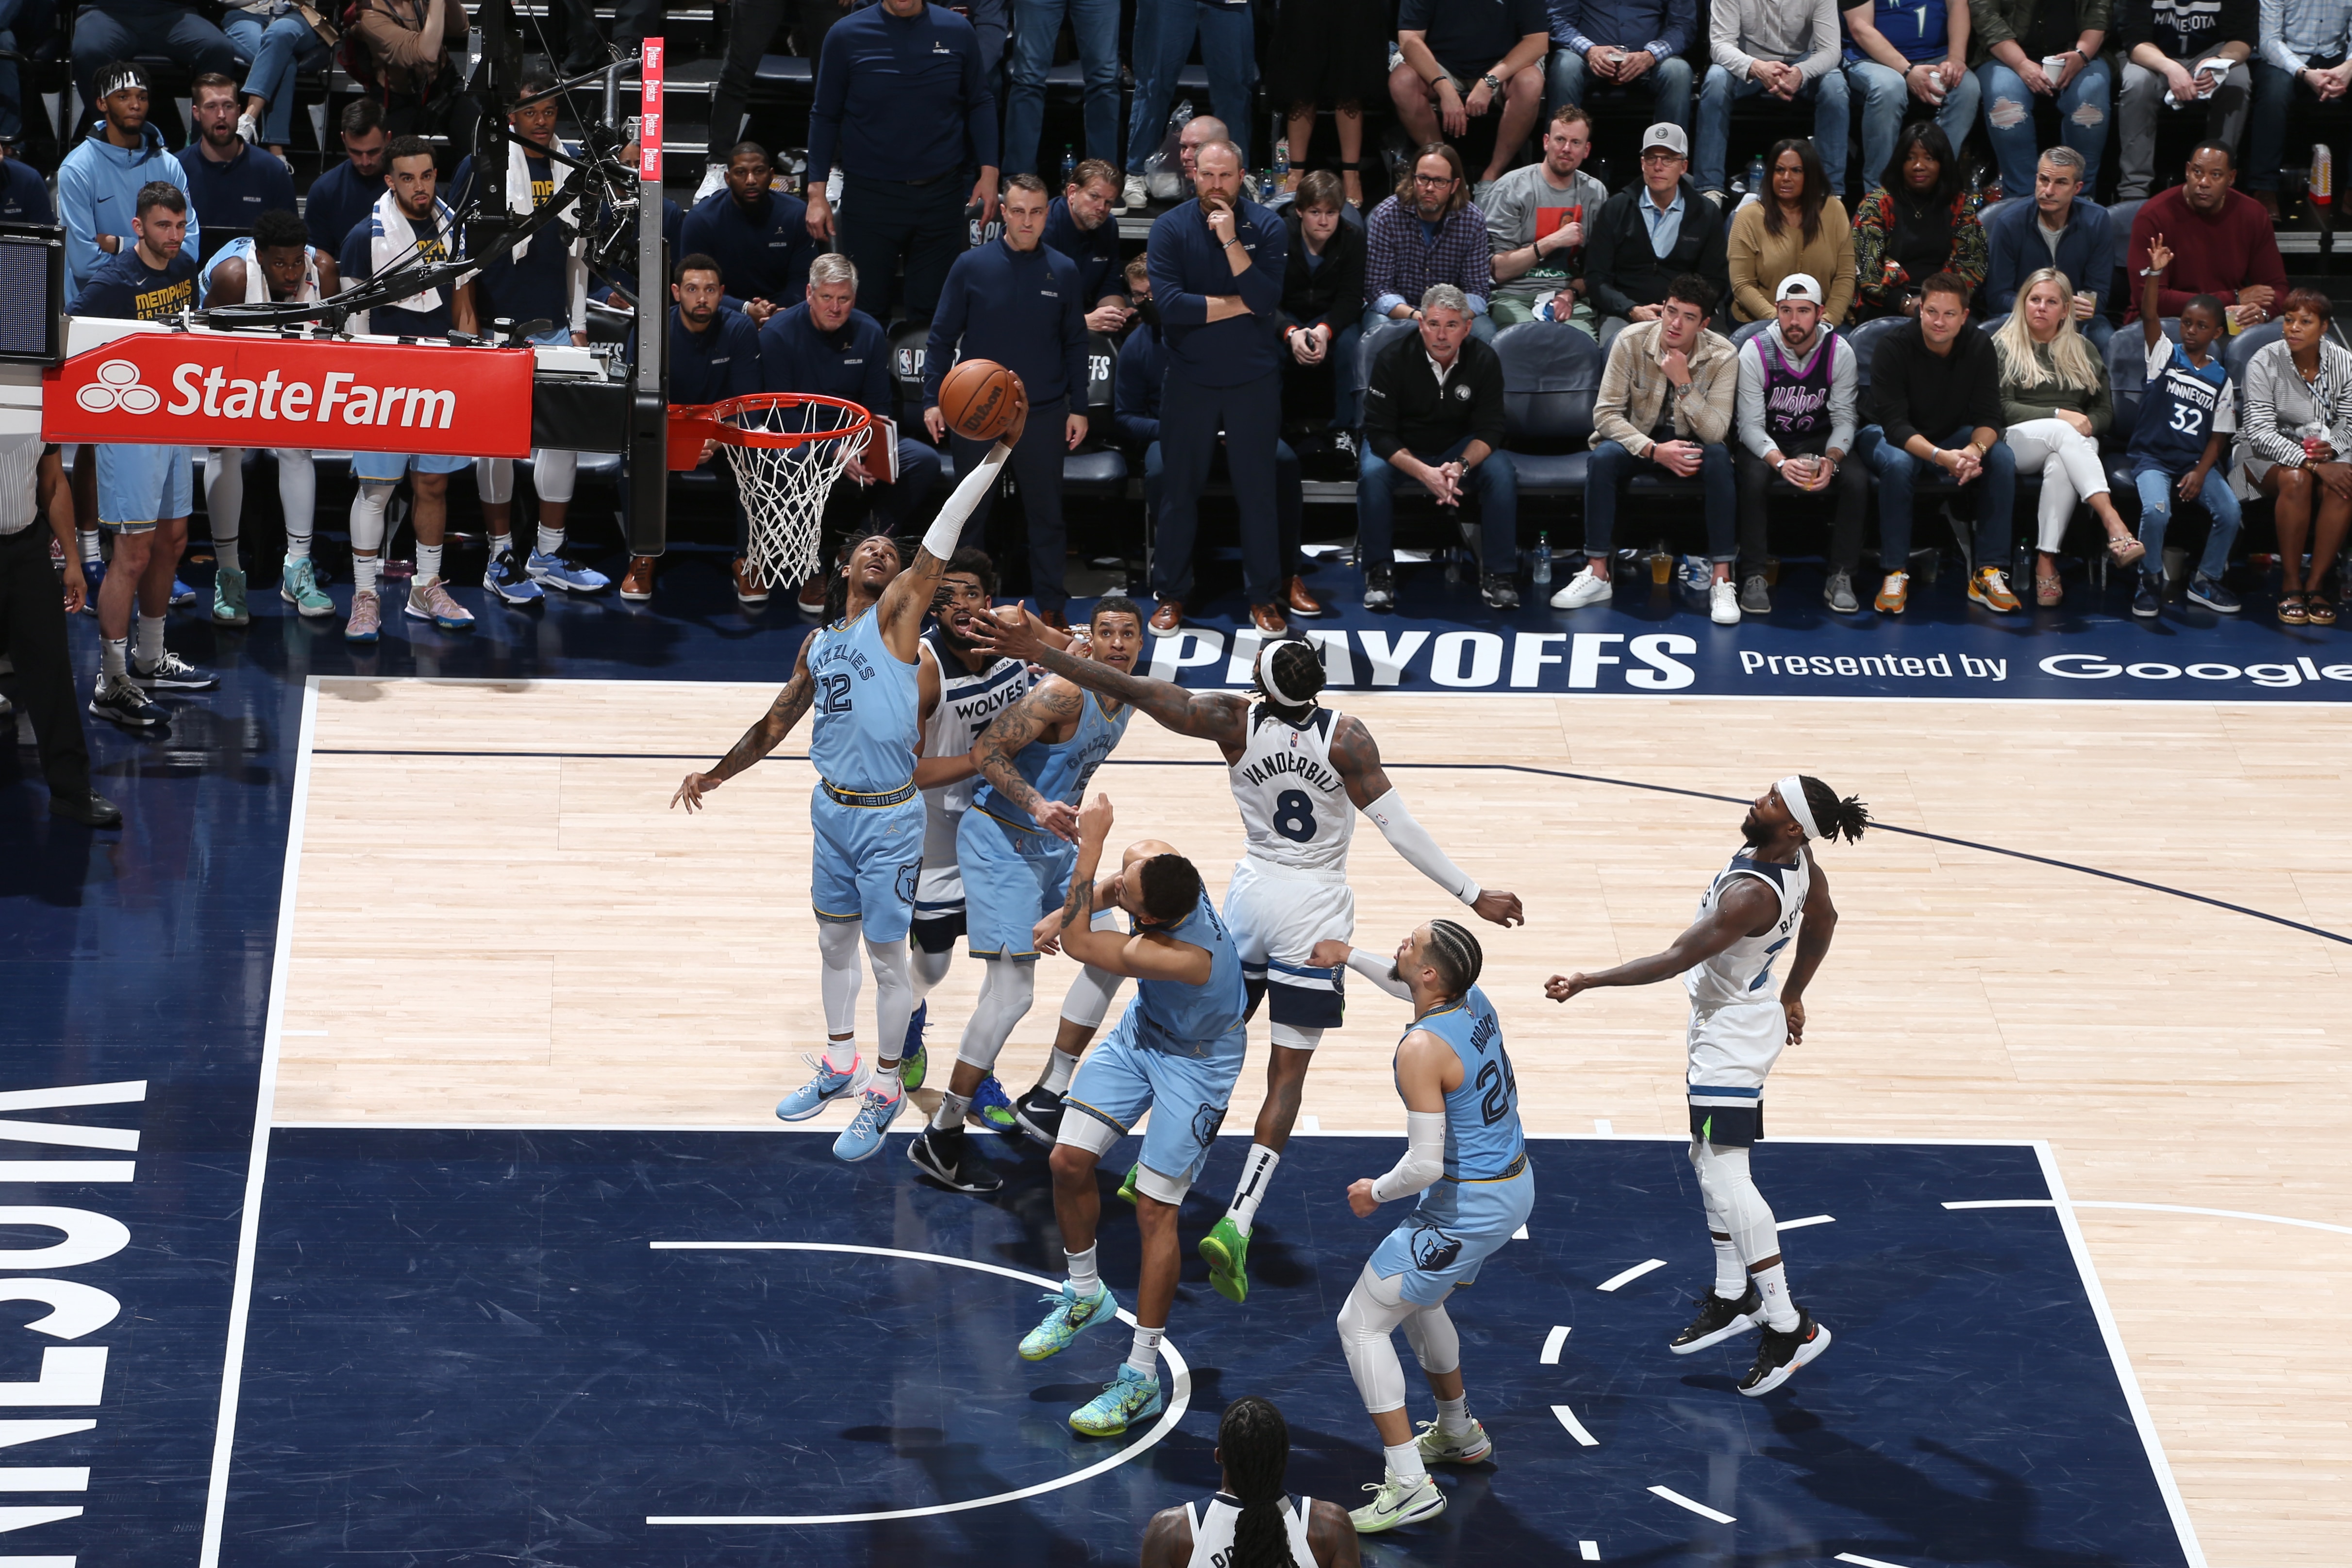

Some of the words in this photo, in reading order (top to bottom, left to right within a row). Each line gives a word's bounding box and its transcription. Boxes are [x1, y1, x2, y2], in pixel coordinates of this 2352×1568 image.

[1913, 4, 1927, 37] 1
[135, 279, 192, 311] MEMPHIS
[963, 385, 1003, 431] Wilson
[2166, 380, 2215, 411] MINNESOTA
[2169, 402, 2202, 436] 32
[1739, 651, 1953, 677] Presented
[1959, 653, 2007, 682] by
[820, 673, 852, 715] 12
[955, 680, 1024, 720] WOLVES
[1242, 751, 1343, 793] VANDERBILT
[1273, 789, 1317, 843] 8
[1470, 1013, 1496, 1055] BROOKS
[1476, 1041, 1517, 1126] 24
